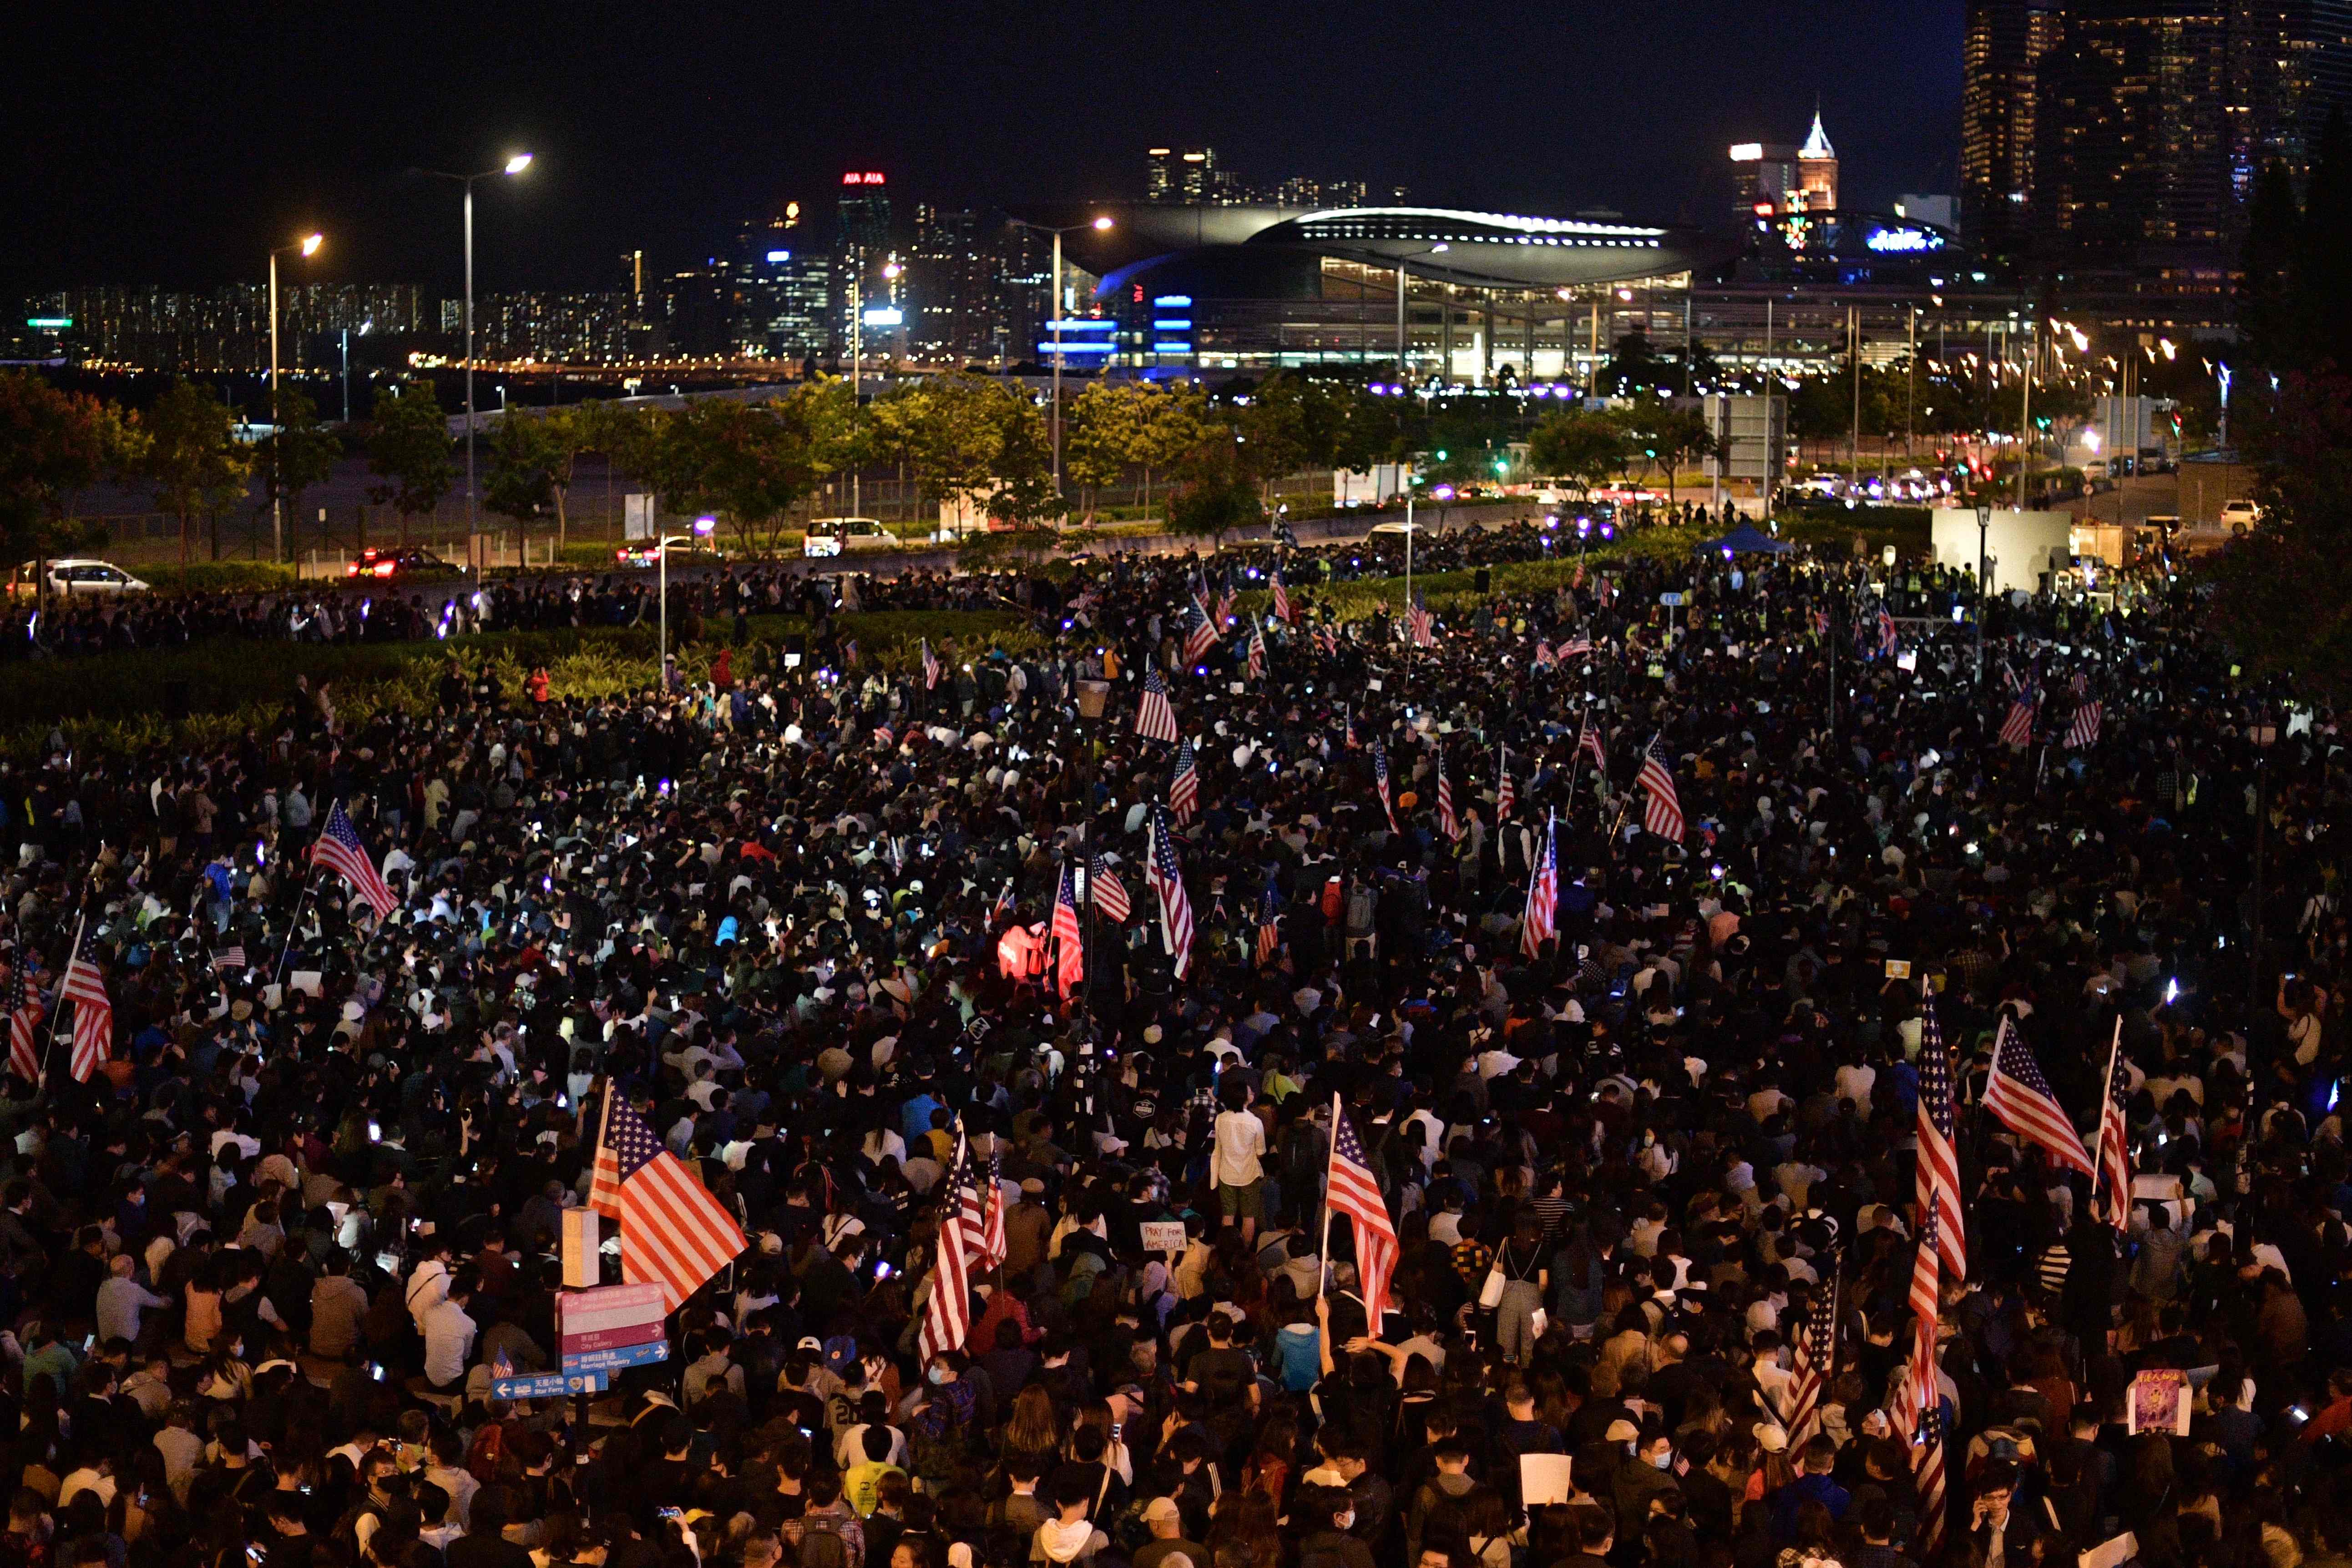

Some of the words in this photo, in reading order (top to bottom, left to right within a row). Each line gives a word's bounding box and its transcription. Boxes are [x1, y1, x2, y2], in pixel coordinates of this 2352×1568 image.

[844, 172, 861, 184] AIA
[864, 172, 885, 184] AIA
[1145, 1227, 1163, 1237] PRAY
[1168, 1228, 1183, 1236] FOR
[1147, 1239, 1184, 1249] AMERICA
[593, 1340, 612, 1348] Gallery
[581, 1360, 605, 1370] Marriage
[607, 1358, 630, 1366] Registry
